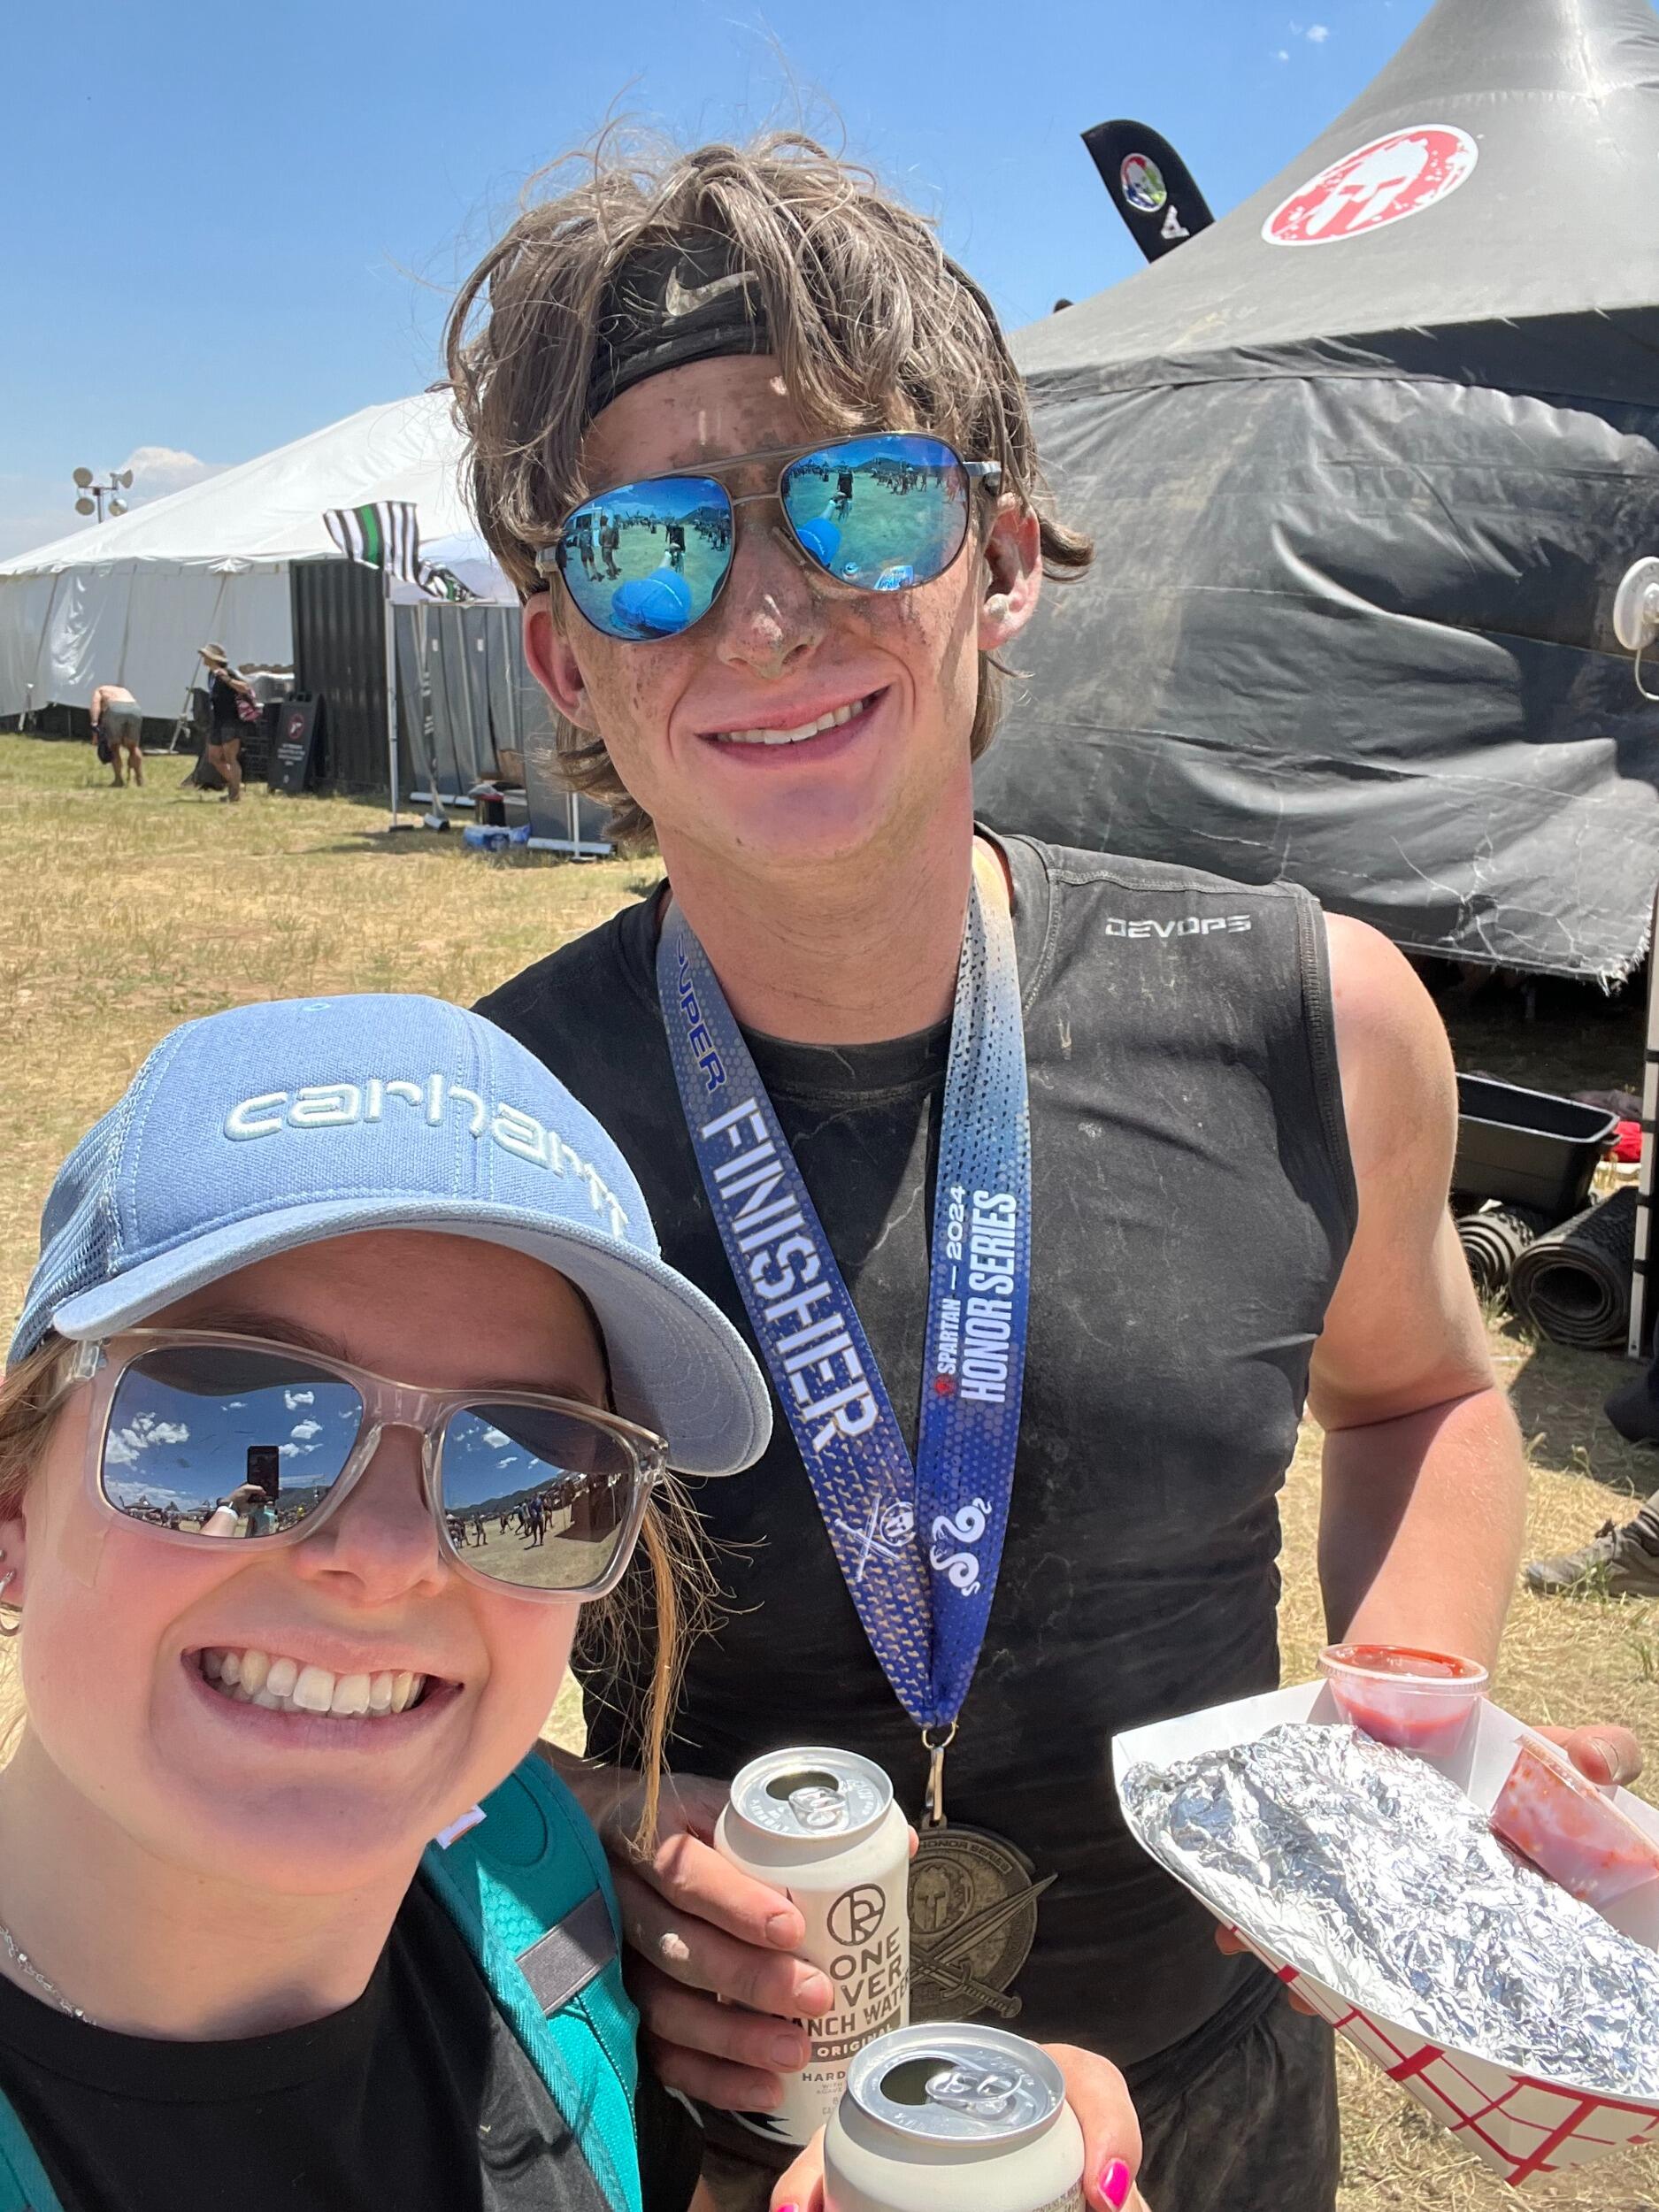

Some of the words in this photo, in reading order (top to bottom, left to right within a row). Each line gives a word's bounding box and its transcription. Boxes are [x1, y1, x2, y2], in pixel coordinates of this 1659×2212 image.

[1105, 915, 1252, 938] DEVOPS
[223, 1073, 629, 1240] carhartt
[946, 1186, 966, 1261] 2024
[969, 1190, 1017, 1294] SERIES
[699, 1097, 879, 1453] FINISHER
[937, 1297, 961, 1376] SPARTAN
[961, 1297, 1013, 1403] HONOR
[829, 1926, 901, 1981] ONE
[829, 1954, 902, 2011] VER
[795, 2012, 856, 2037] NCH
[802, 2070, 847, 2082] HARD
